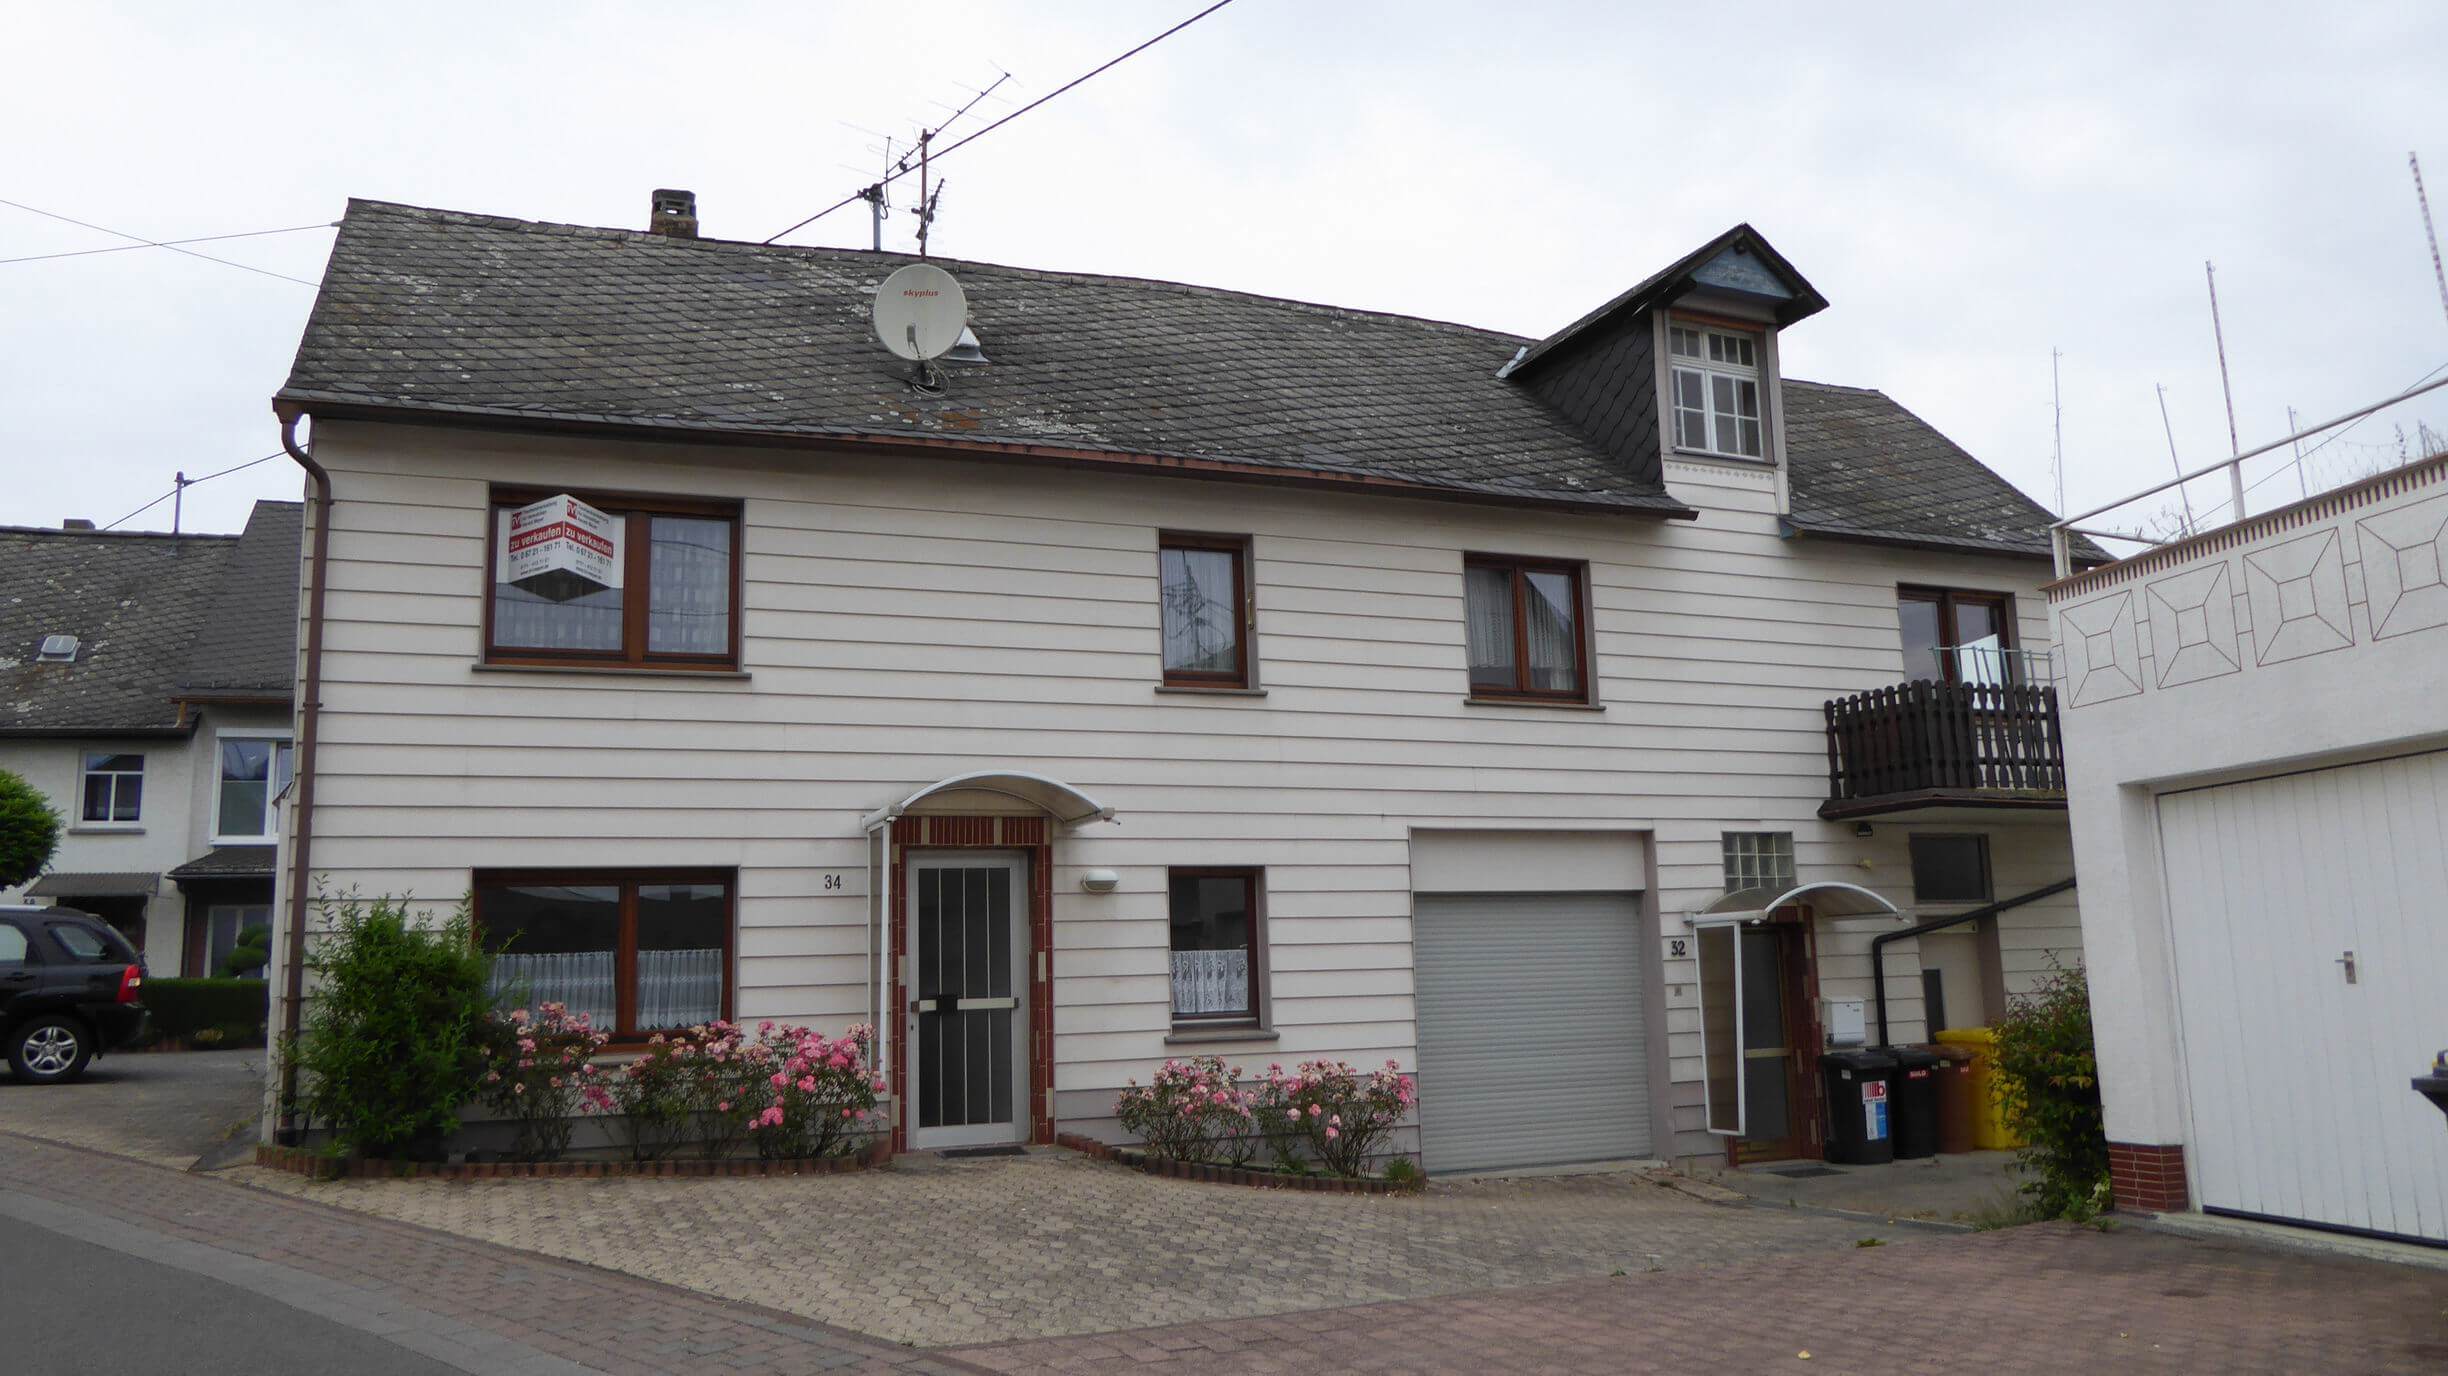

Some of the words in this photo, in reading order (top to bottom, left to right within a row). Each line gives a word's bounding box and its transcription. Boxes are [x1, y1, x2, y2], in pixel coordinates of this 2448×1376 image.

[511, 541, 520, 551] zu
[520, 527, 561, 545] verkaufen
[566, 527, 576, 538] zu
[577, 531, 613, 557] verkaufen
[825, 874, 841, 890] 34
[1671, 940, 1686, 956] 32
